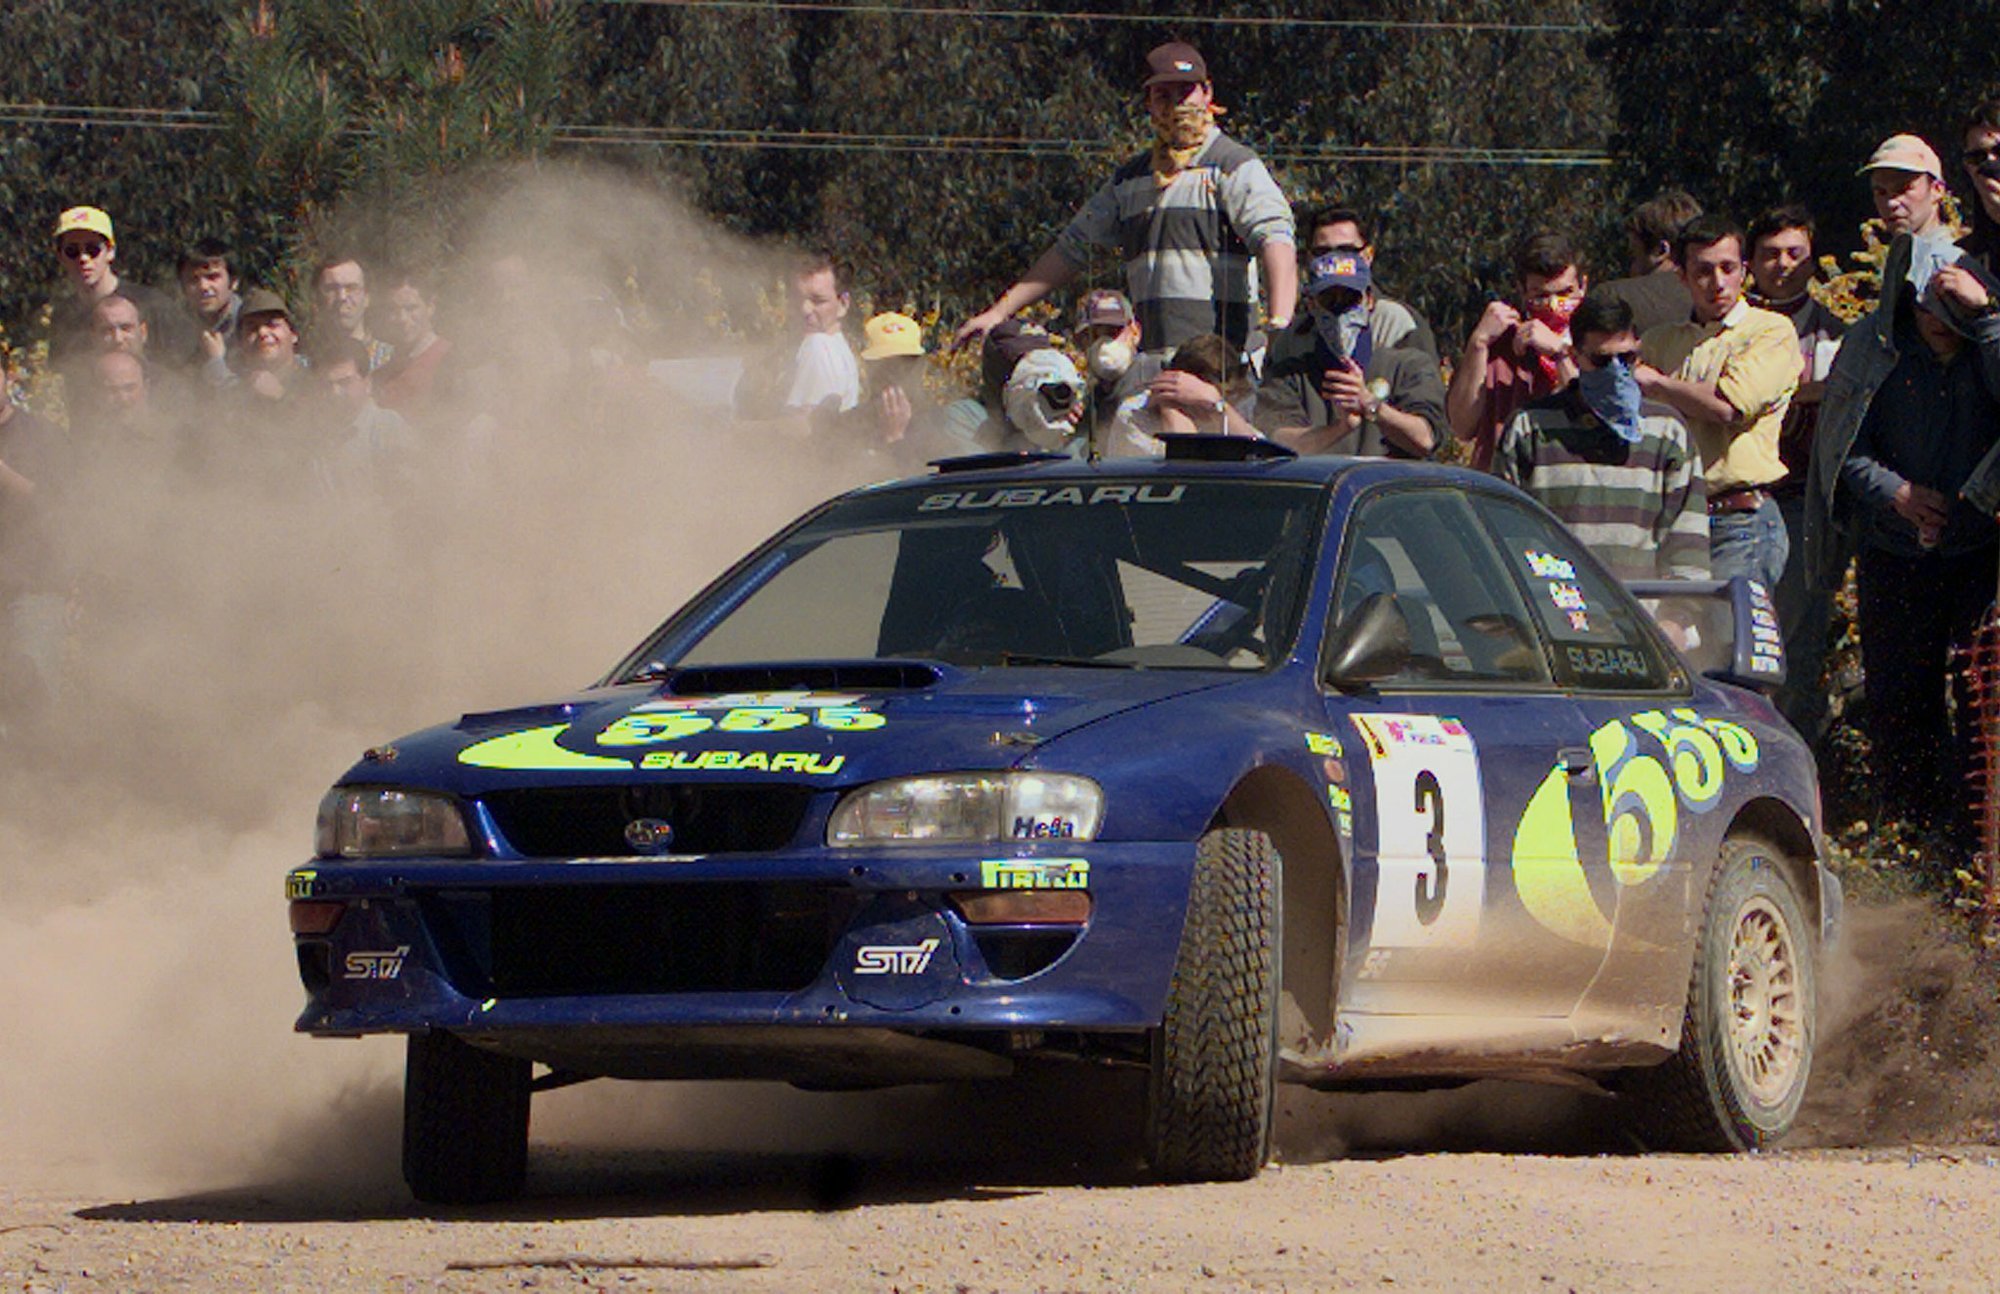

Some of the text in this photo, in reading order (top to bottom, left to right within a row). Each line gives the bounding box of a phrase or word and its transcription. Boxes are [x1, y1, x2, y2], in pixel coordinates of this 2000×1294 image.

[917, 485, 1187, 512] SUBARU
[1567, 647, 1648, 676] SUBARU
[596, 706, 886, 746] 555
[639, 750, 845, 774] SUBARU
[1415, 769, 1448, 926] 3
